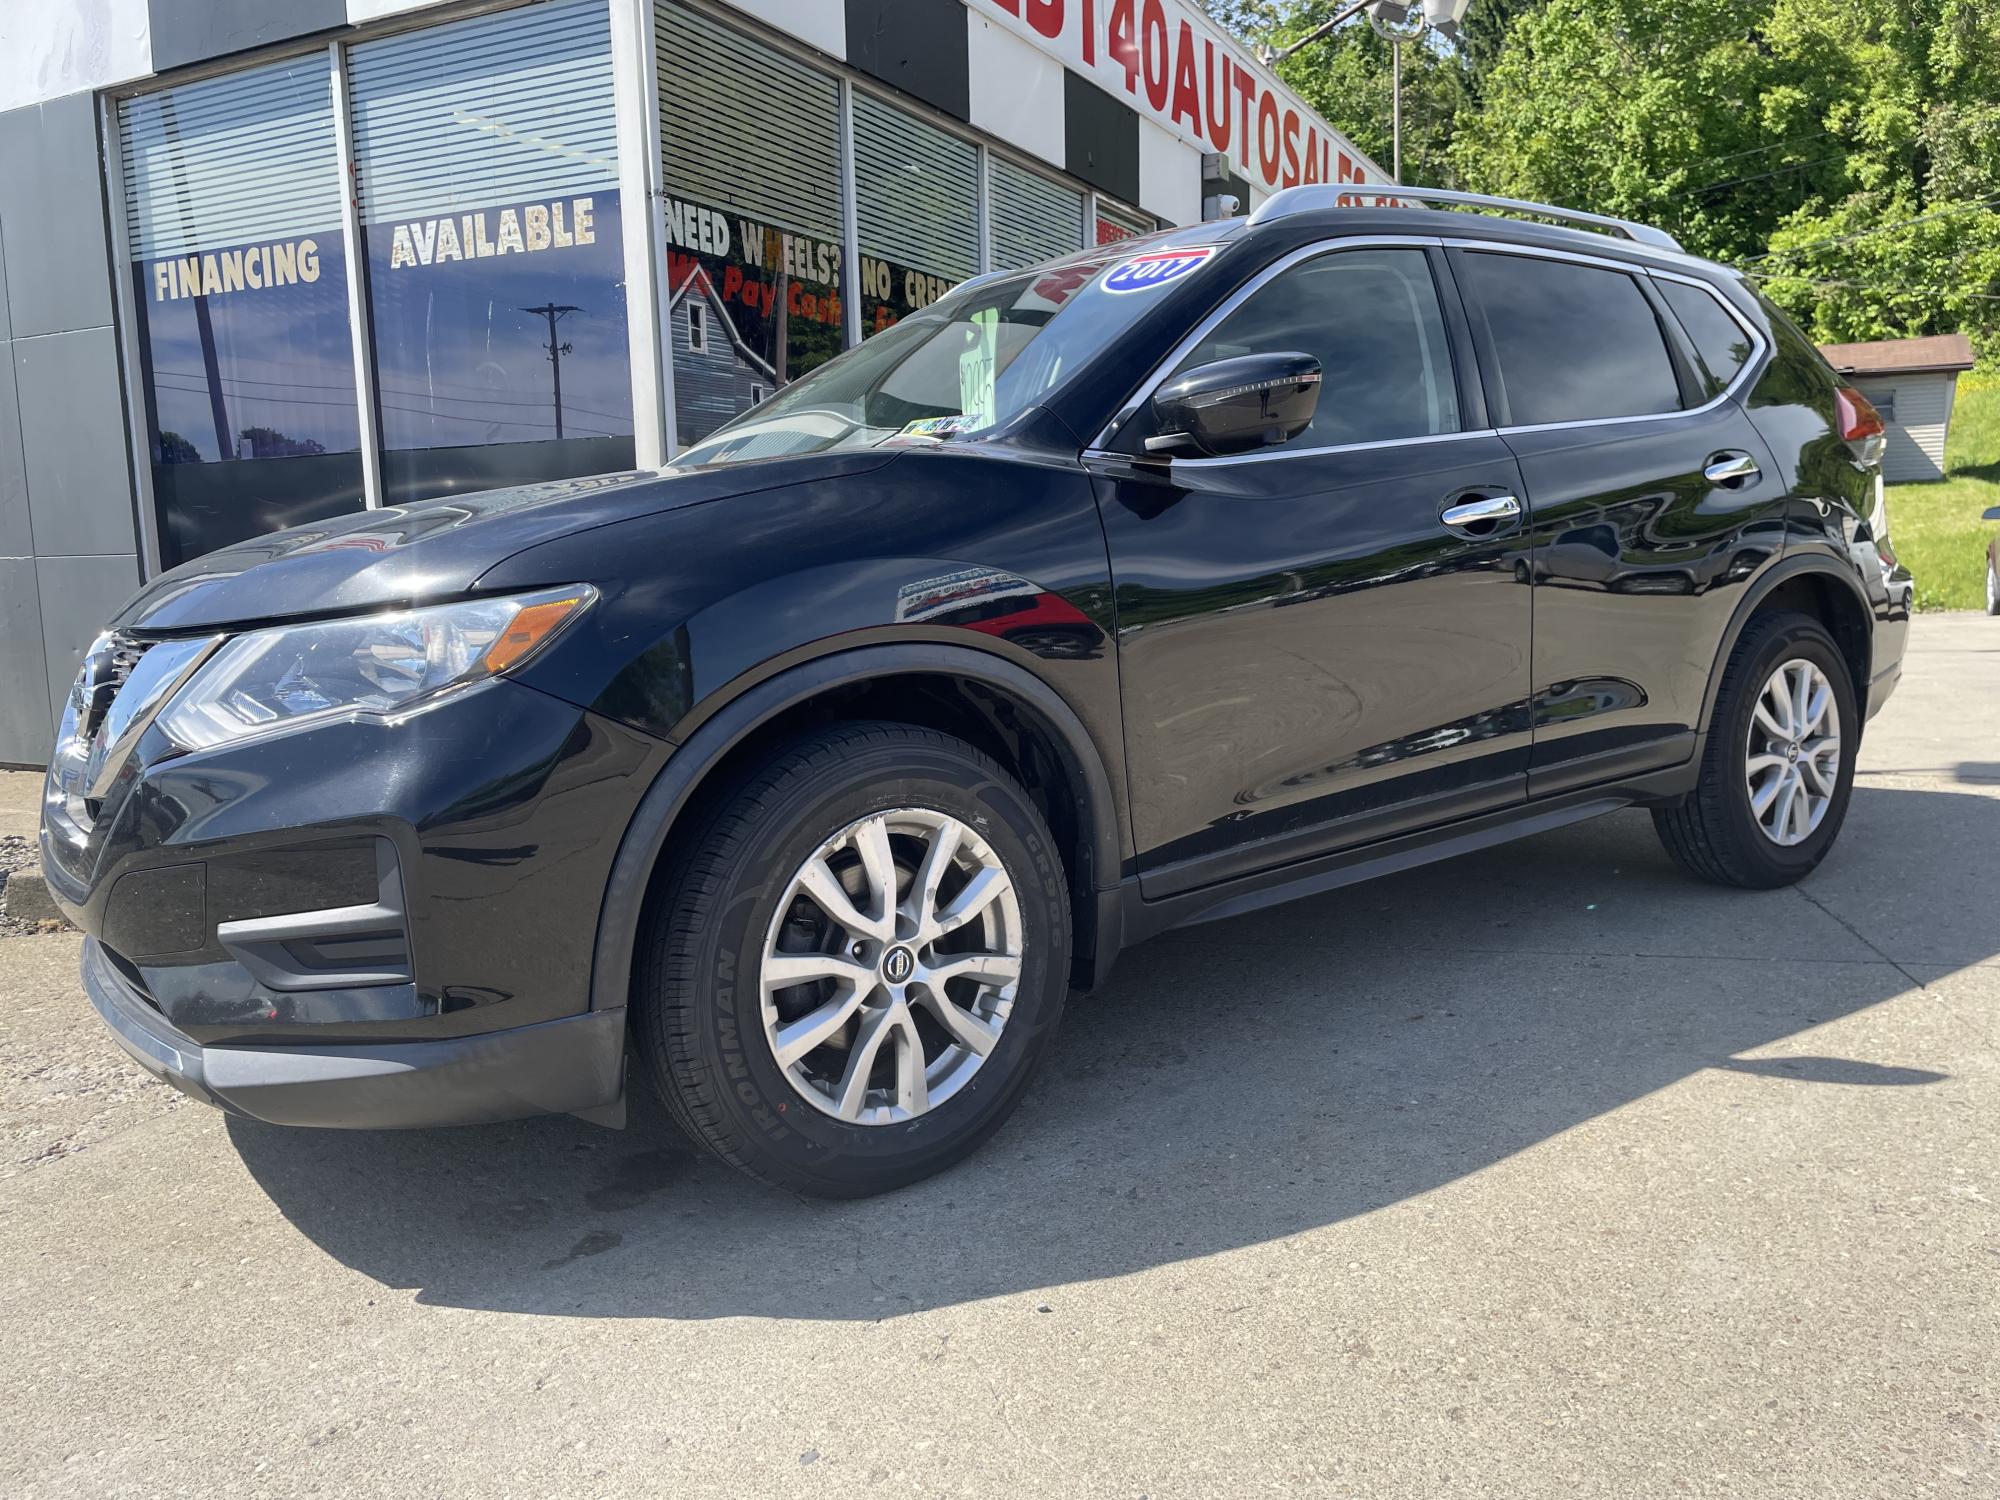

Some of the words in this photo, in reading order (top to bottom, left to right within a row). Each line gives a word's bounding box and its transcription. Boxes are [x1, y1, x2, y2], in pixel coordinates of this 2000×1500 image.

[153, 239, 320, 301] FINANCING
[391, 198, 595, 270] AVAILABLE
[664, 198, 731, 257] NEED
[739, 219, 842, 288] WHEELS?
[861, 256, 892, 301] NO
[904, 270, 959, 309] CRED
[723, 265, 777, 319] Pay
[788, 281, 842, 327] Cash
[1110, 258, 1194, 282] 2017
[716, 947, 791, 1142] IRONMAN
